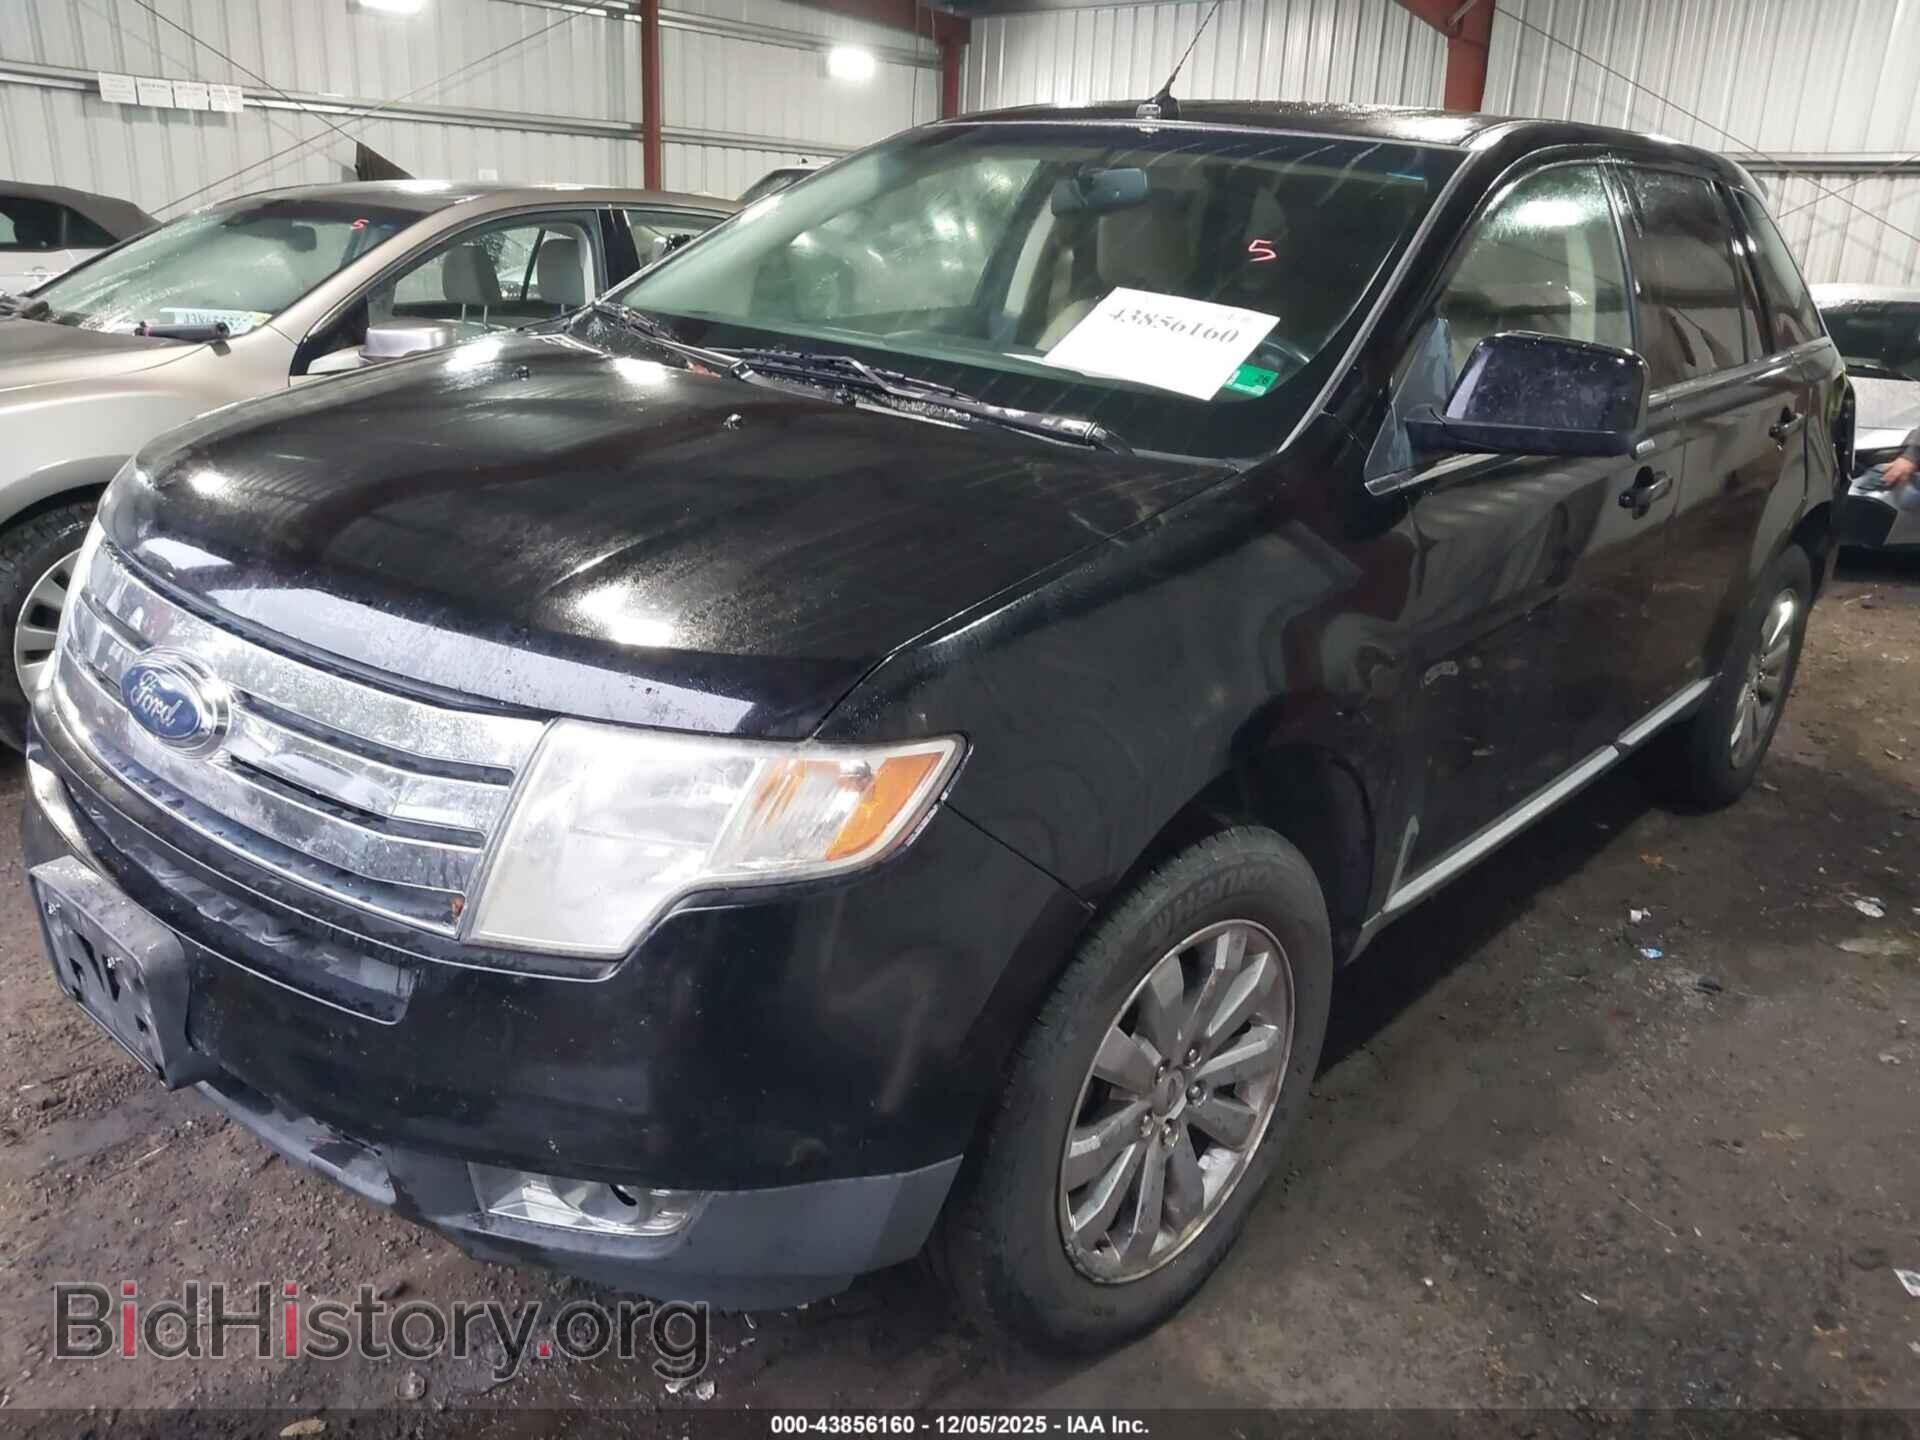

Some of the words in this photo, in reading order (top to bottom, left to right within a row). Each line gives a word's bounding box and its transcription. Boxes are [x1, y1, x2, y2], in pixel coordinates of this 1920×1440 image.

[1248, 239, 1277, 262] 5
[1110, 308, 1239, 342] 43856160
[129, 669, 184, 728] Ford
